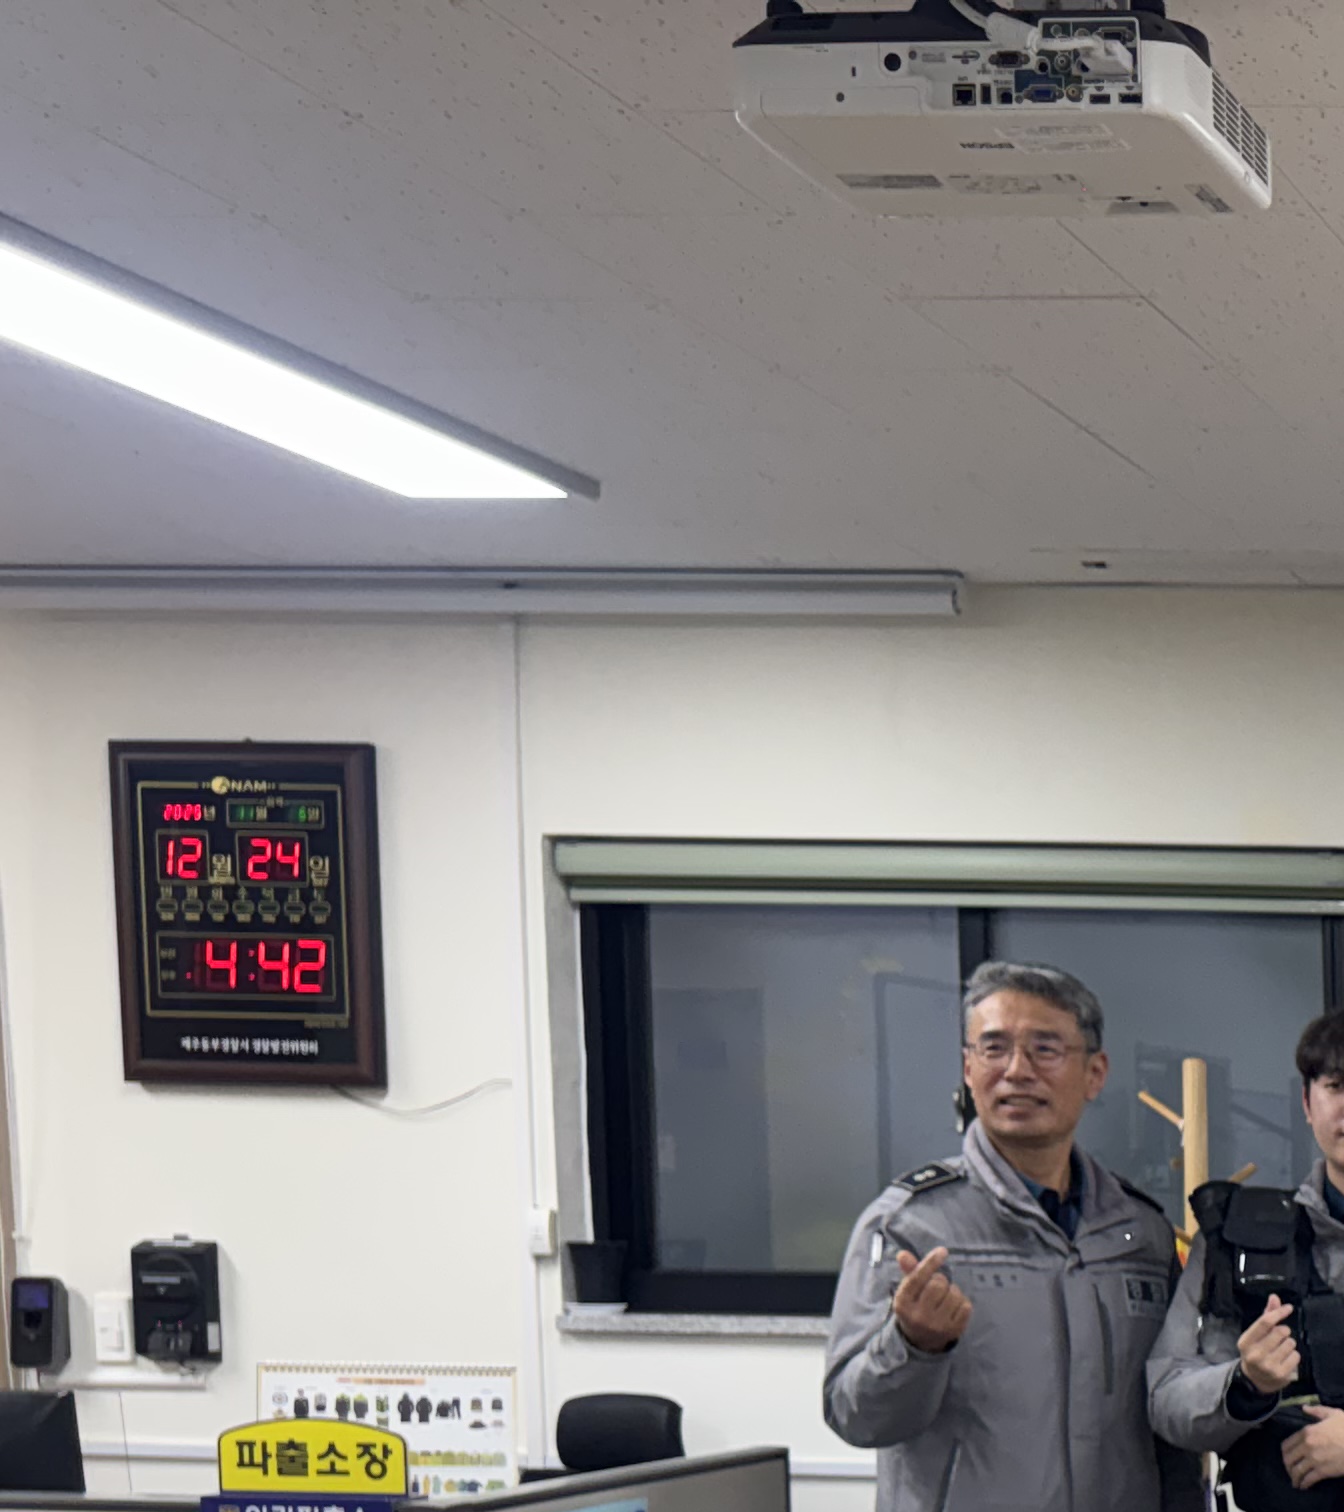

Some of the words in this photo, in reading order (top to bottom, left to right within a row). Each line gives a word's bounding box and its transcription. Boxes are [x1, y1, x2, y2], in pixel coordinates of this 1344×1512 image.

[165, 837, 203, 879] 12
[247, 838, 301, 880] 24
[205, 939, 326, 993] 4:42
[236, 1438, 393, 1480] 파출소장
